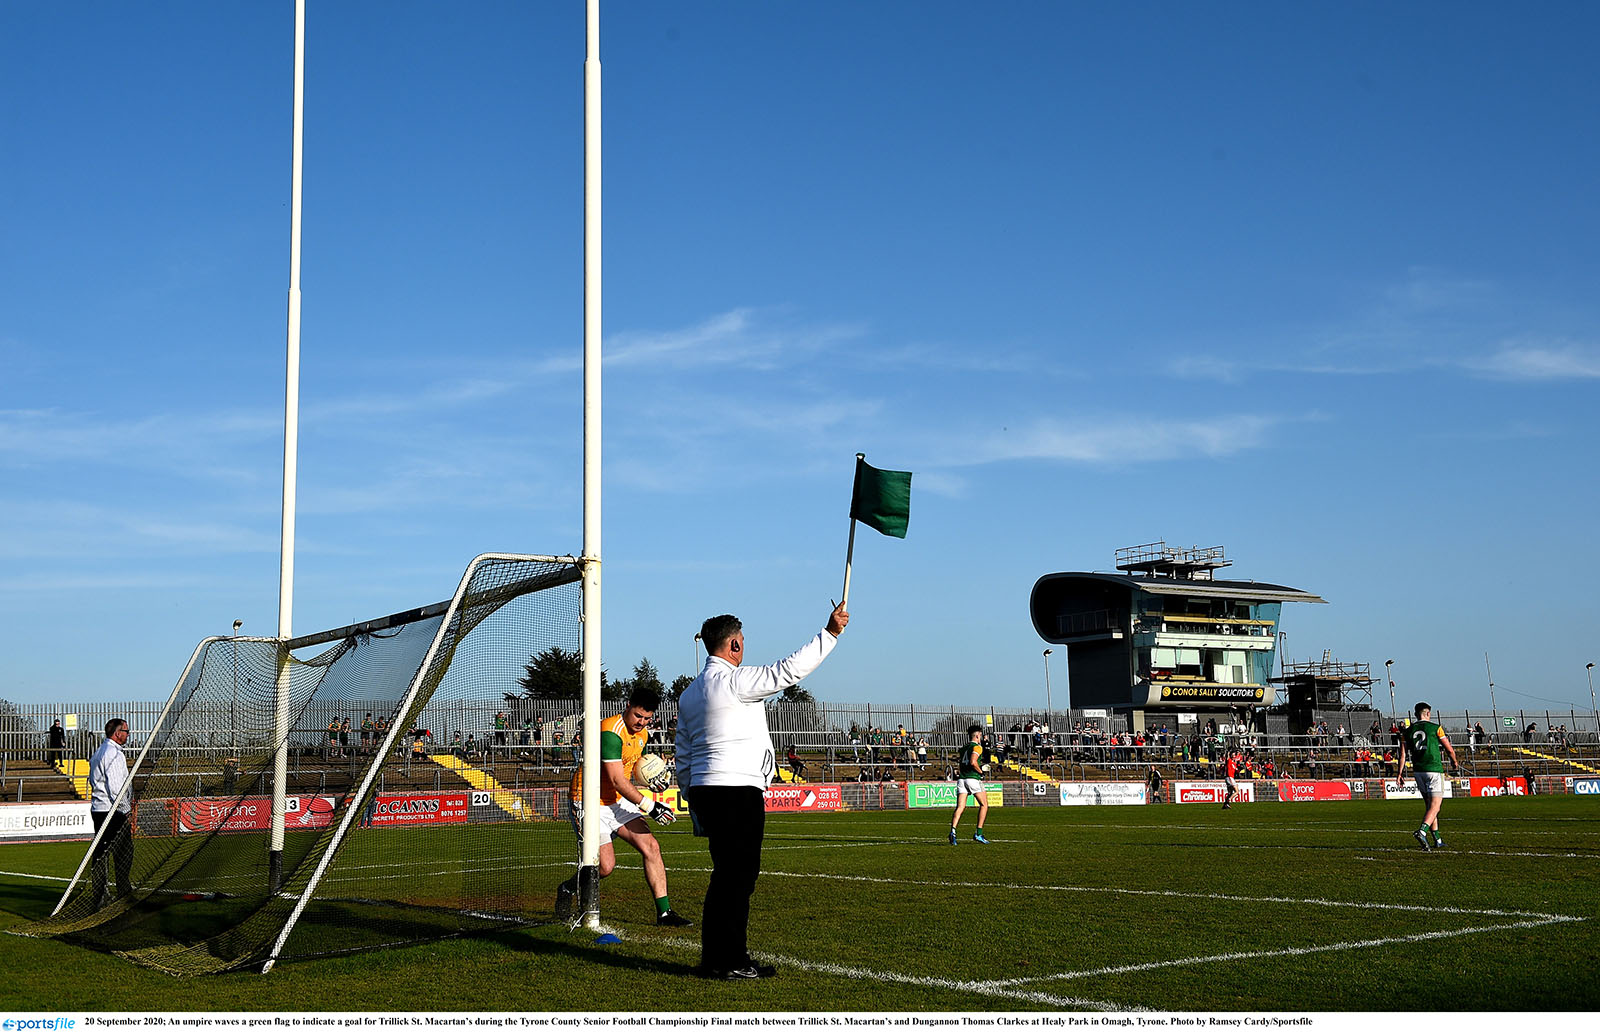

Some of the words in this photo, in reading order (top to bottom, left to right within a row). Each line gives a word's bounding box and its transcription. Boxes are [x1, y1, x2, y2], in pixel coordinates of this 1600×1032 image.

[1172, 687, 1198, 696] CONOR
[1198, 688, 1218, 697] SALLY
[1218, 688, 1254, 697] SOLICITORS
[1413, 730, 1427, 750] 2
[1034, 784, 1045, 793] 45
[1292, 783, 1314, 794] tyrone
[474, 793, 489, 804] 20
[774, 790, 802, 798] DOODY
[818, 792, 830, 800] 028
[1183, 792, 1213, 801] Chronicle
[1217, 789, 1249, 802] Heald
[772, 798, 801, 808] PARTS
[209, 803, 257, 818] tyrone
[24, 815, 86, 829] EQUIPMENT
